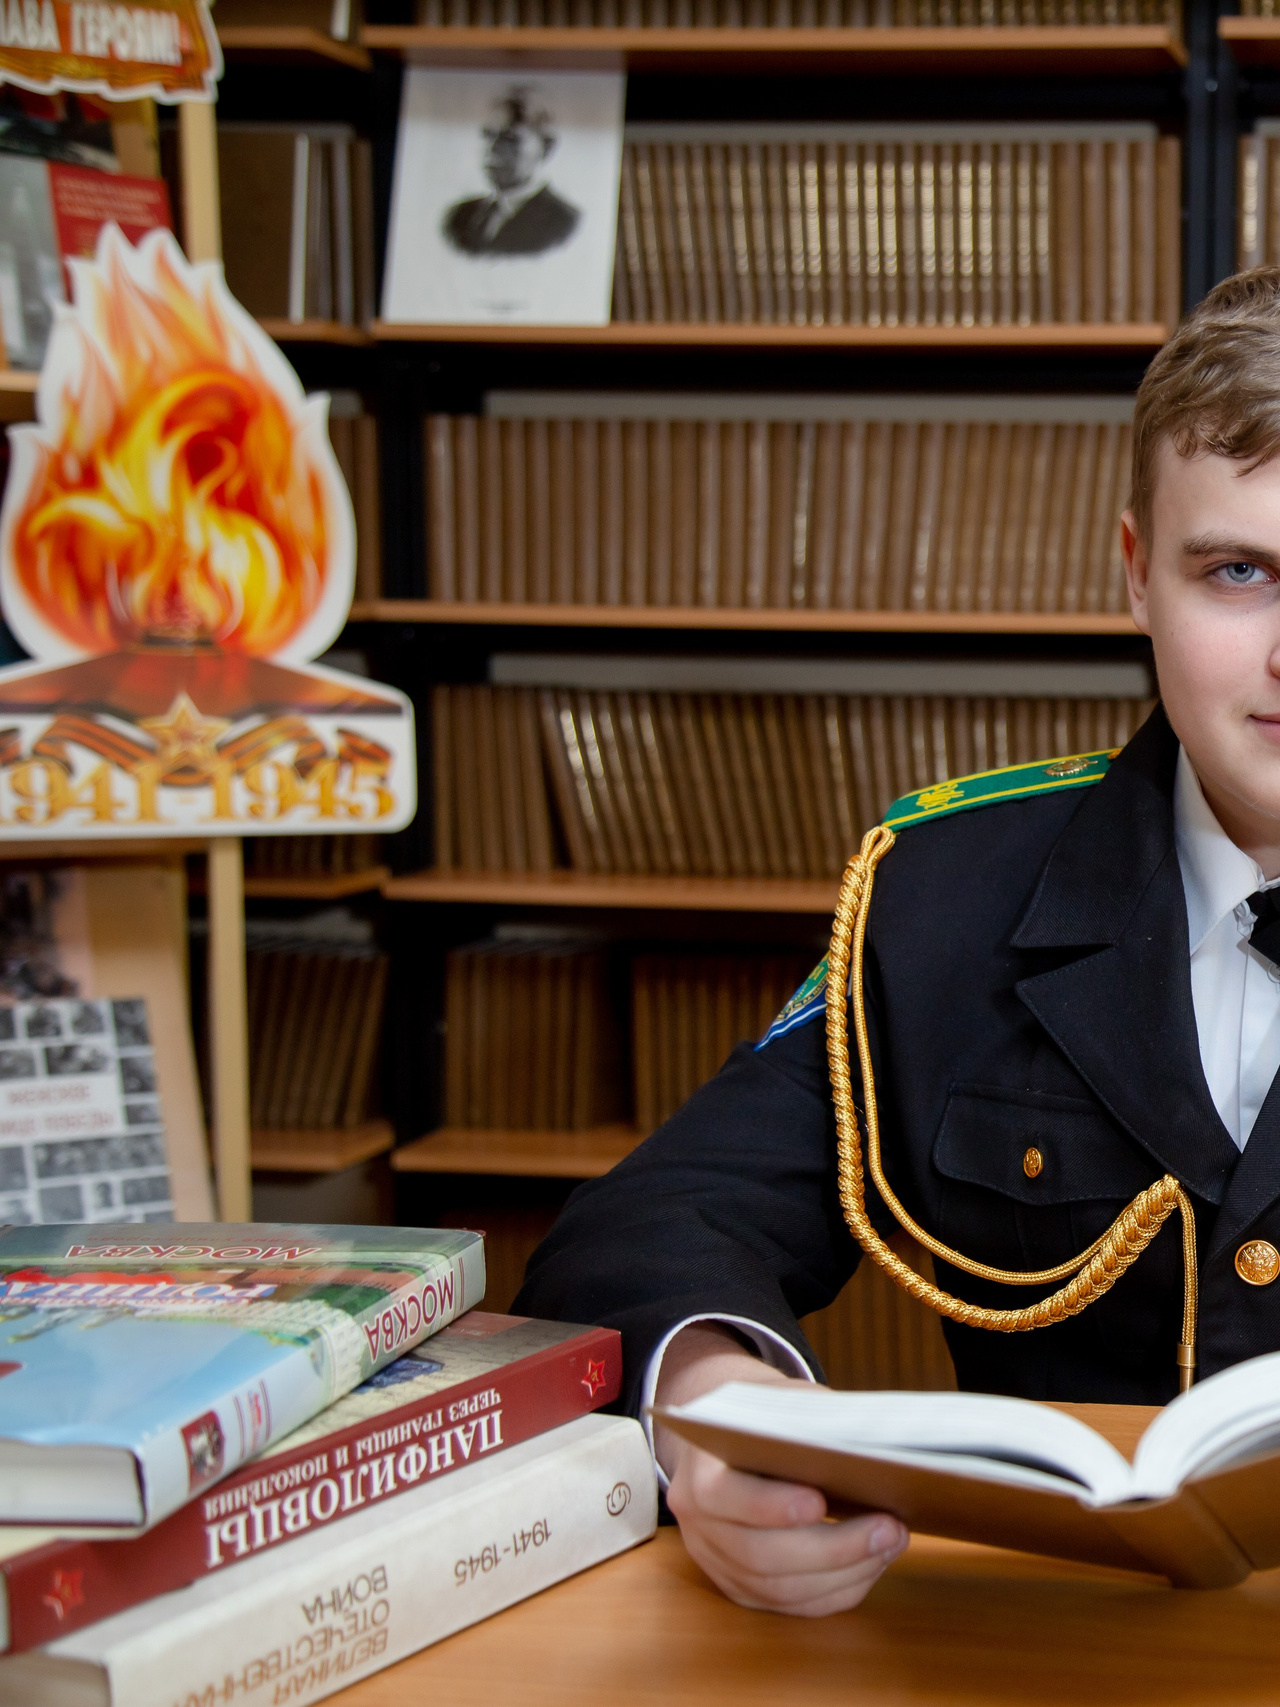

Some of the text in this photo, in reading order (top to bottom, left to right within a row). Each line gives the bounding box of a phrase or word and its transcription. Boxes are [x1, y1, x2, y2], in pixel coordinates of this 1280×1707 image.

[71, 3, 183, 66] ГЕРОЯМ!
[65, 1244, 321, 1261] МОСКВА
[364, 1268, 456, 1364] МОСКВА
[205, 1388, 502, 1522] ЧЕРЕЗ ГРАНИЦЫ И ПОКОЛЕНИЯ
[205, 1410, 504, 1569] ПАНФИЛОВЦЫ
[454, 1518, 552, 1587] 1941-1945
[303, 1563, 388, 1625] ВОЙНА
[273, 1627, 389, 1706] ВЕЛИКАЯ
